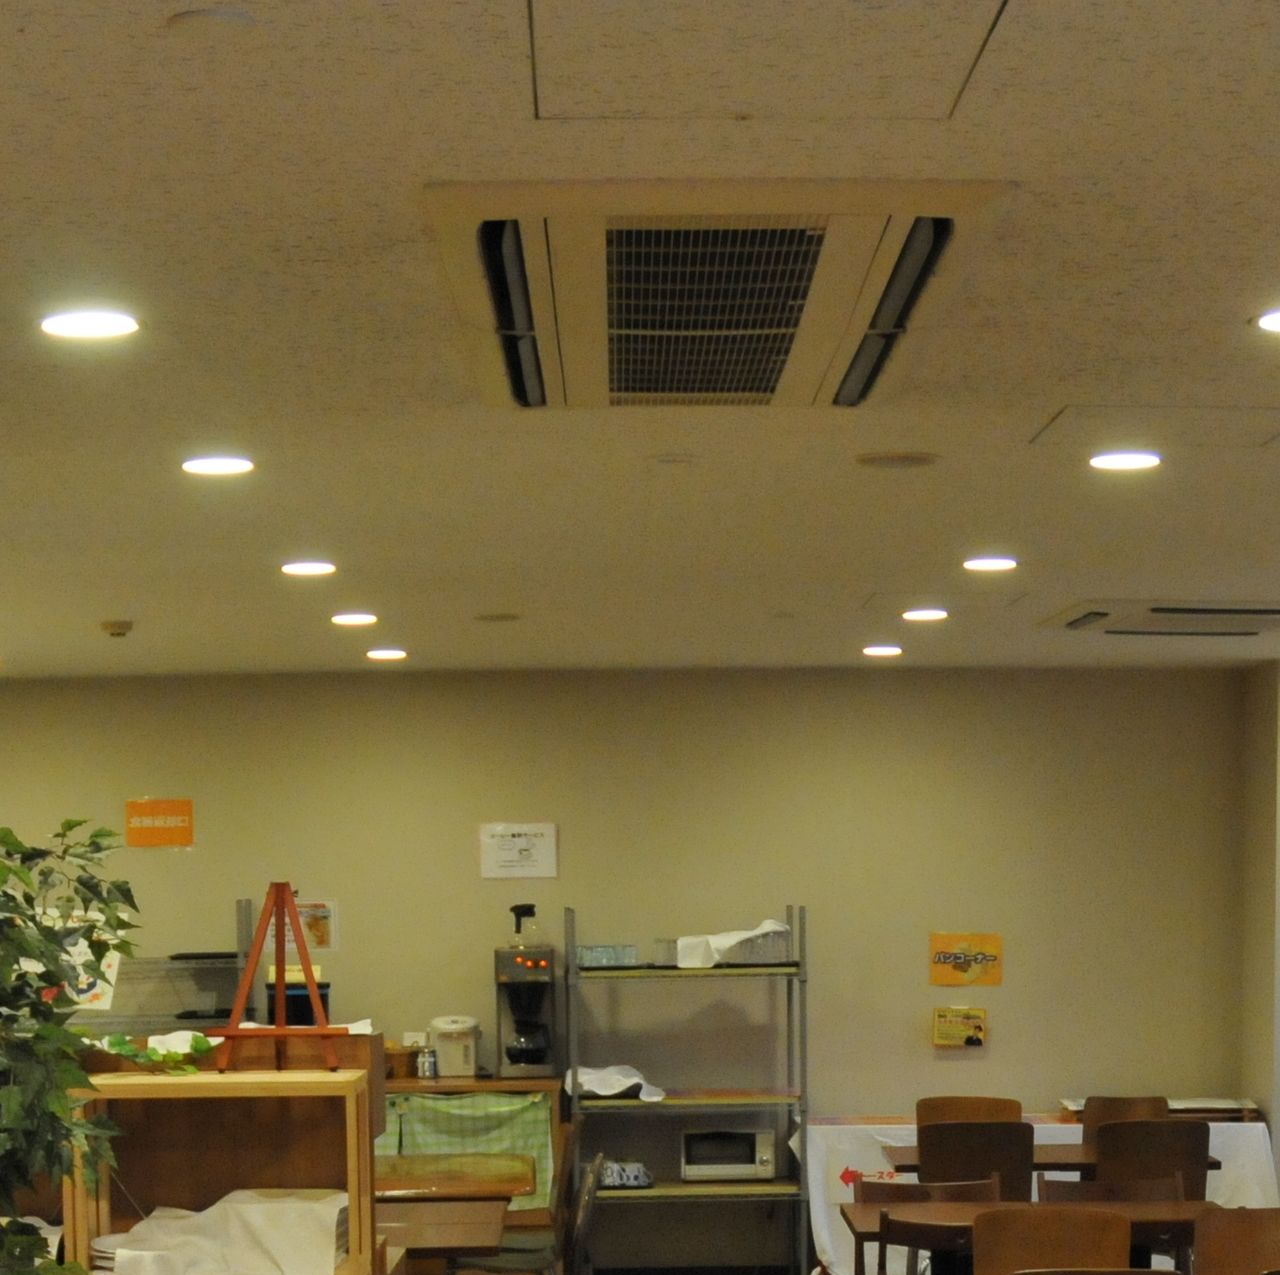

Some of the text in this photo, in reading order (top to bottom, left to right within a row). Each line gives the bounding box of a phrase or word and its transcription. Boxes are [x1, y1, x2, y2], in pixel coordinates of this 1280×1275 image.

[933, 950, 997, 965] パンコーナー
